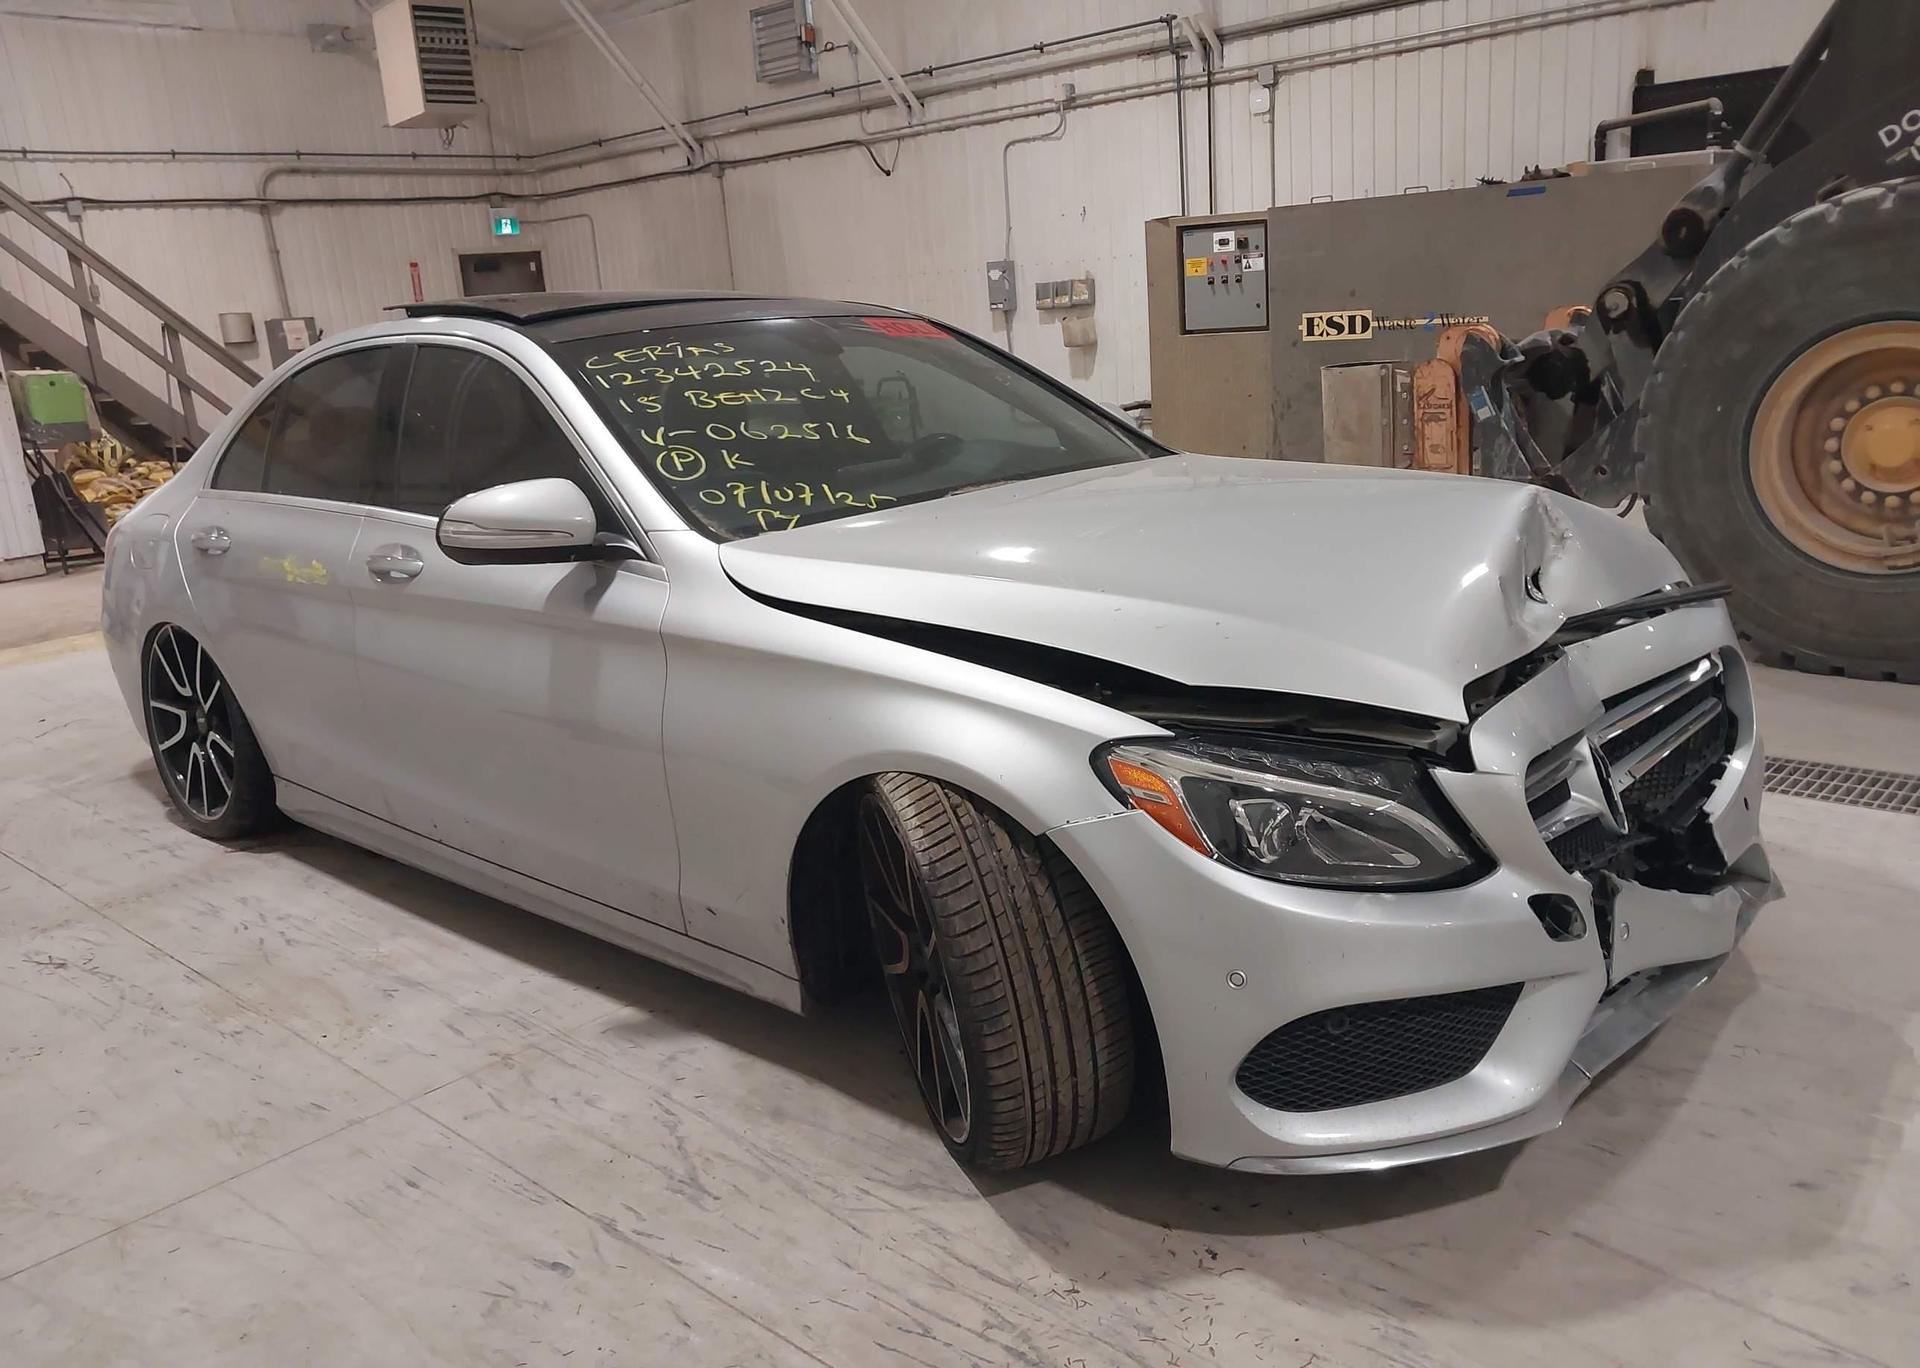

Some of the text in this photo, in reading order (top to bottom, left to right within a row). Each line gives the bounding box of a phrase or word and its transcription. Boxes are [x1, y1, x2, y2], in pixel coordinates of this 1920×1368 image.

[1878, 109, 1920, 147] DO
[1305, 313, 1371, 337] ESD
[1376, 316, 1416, 331] Waste
[1440, 313, 1482, 328] Water
[585, 341, 735, 369] CERTAS
[595, 359, 817, 389] 12342524
[721, 450, 755, 469] K
